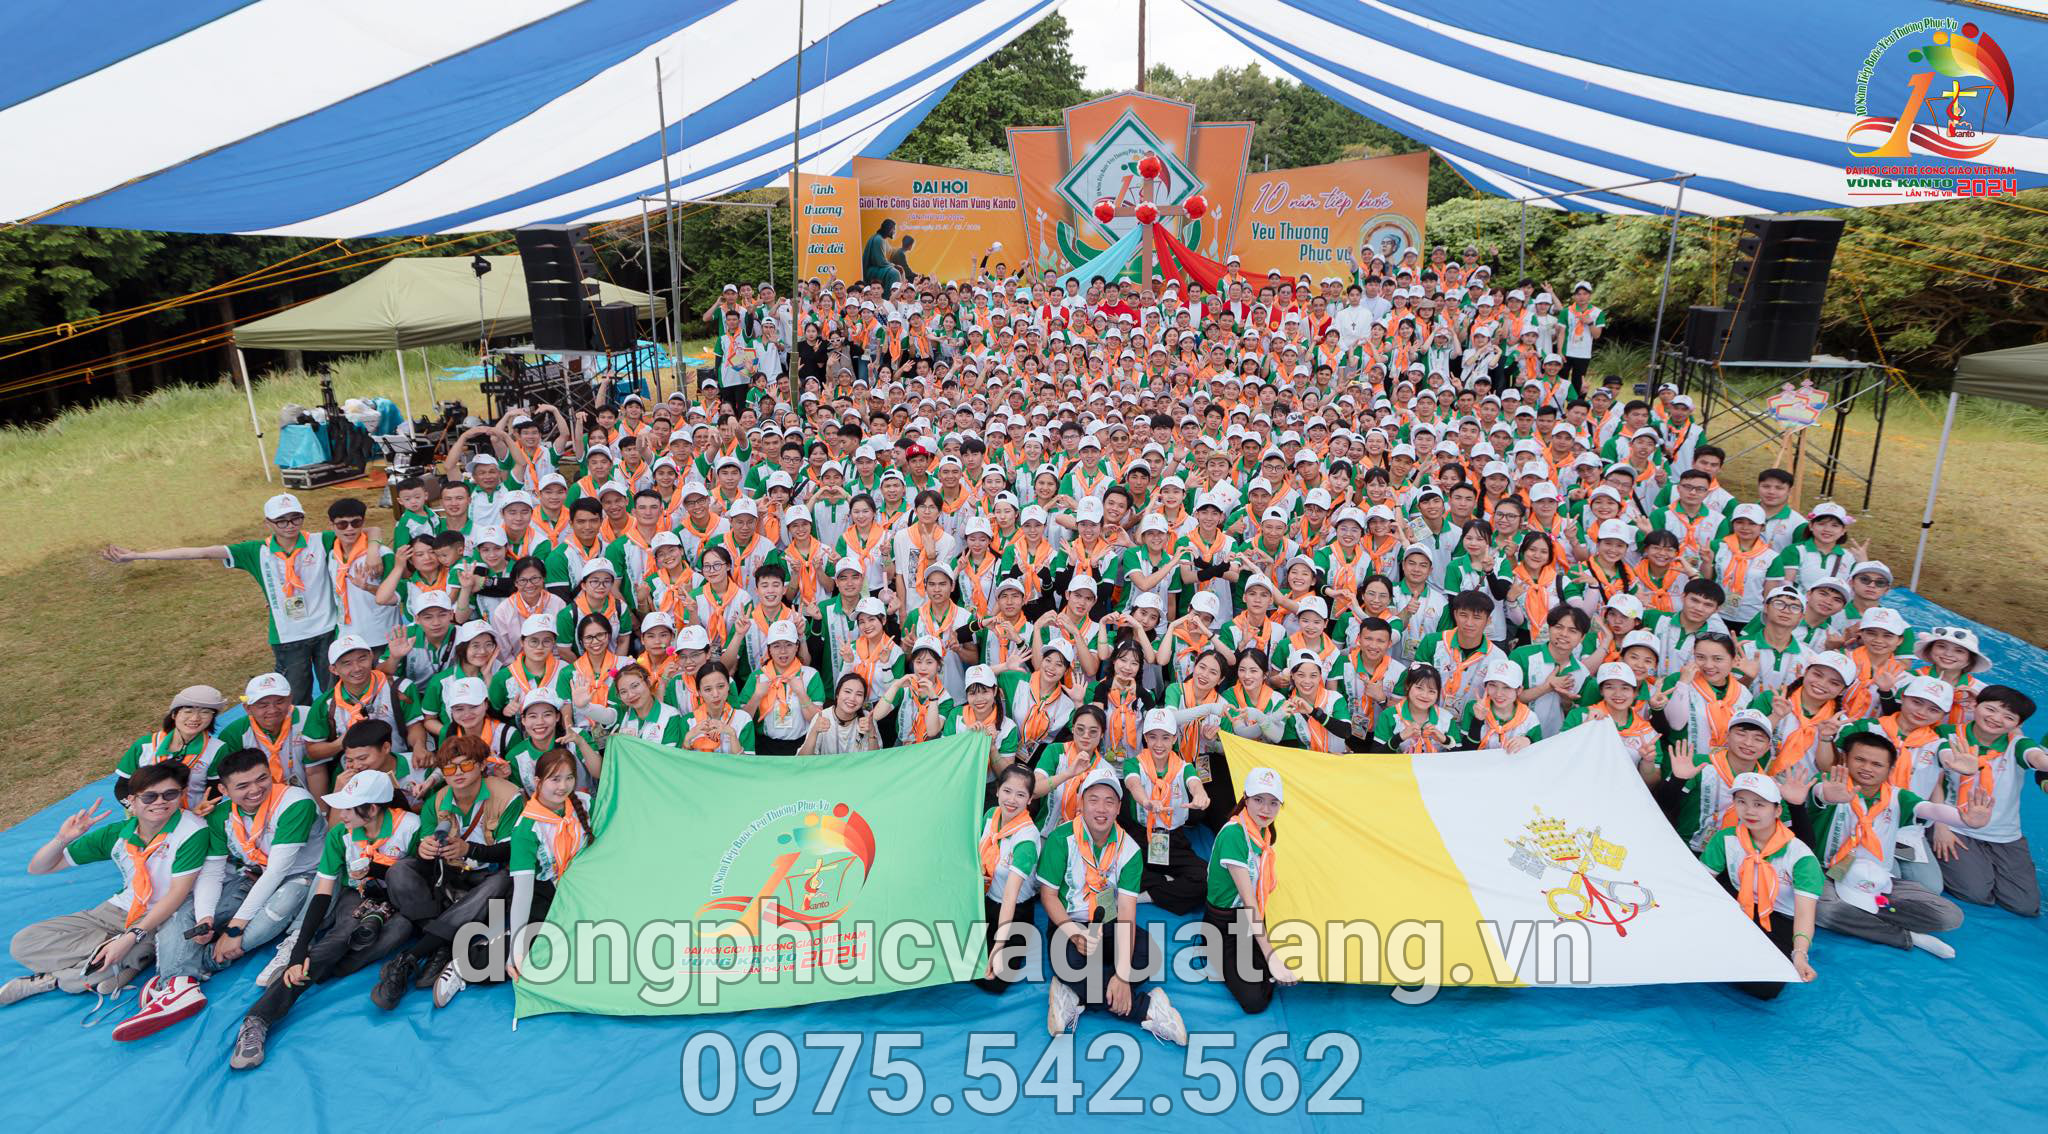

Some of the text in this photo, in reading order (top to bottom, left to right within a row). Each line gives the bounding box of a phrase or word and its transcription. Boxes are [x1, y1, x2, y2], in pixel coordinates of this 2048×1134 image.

[949, 198, 968, 209] Nam
[993, 198, 1016, 209] Kanto
[1252, 182, 1289, 214] 10
[843, 930, 867, 942] NAM
[737, 951, 797, 965] KANTO
[800, 943, 867, 969] 2024
